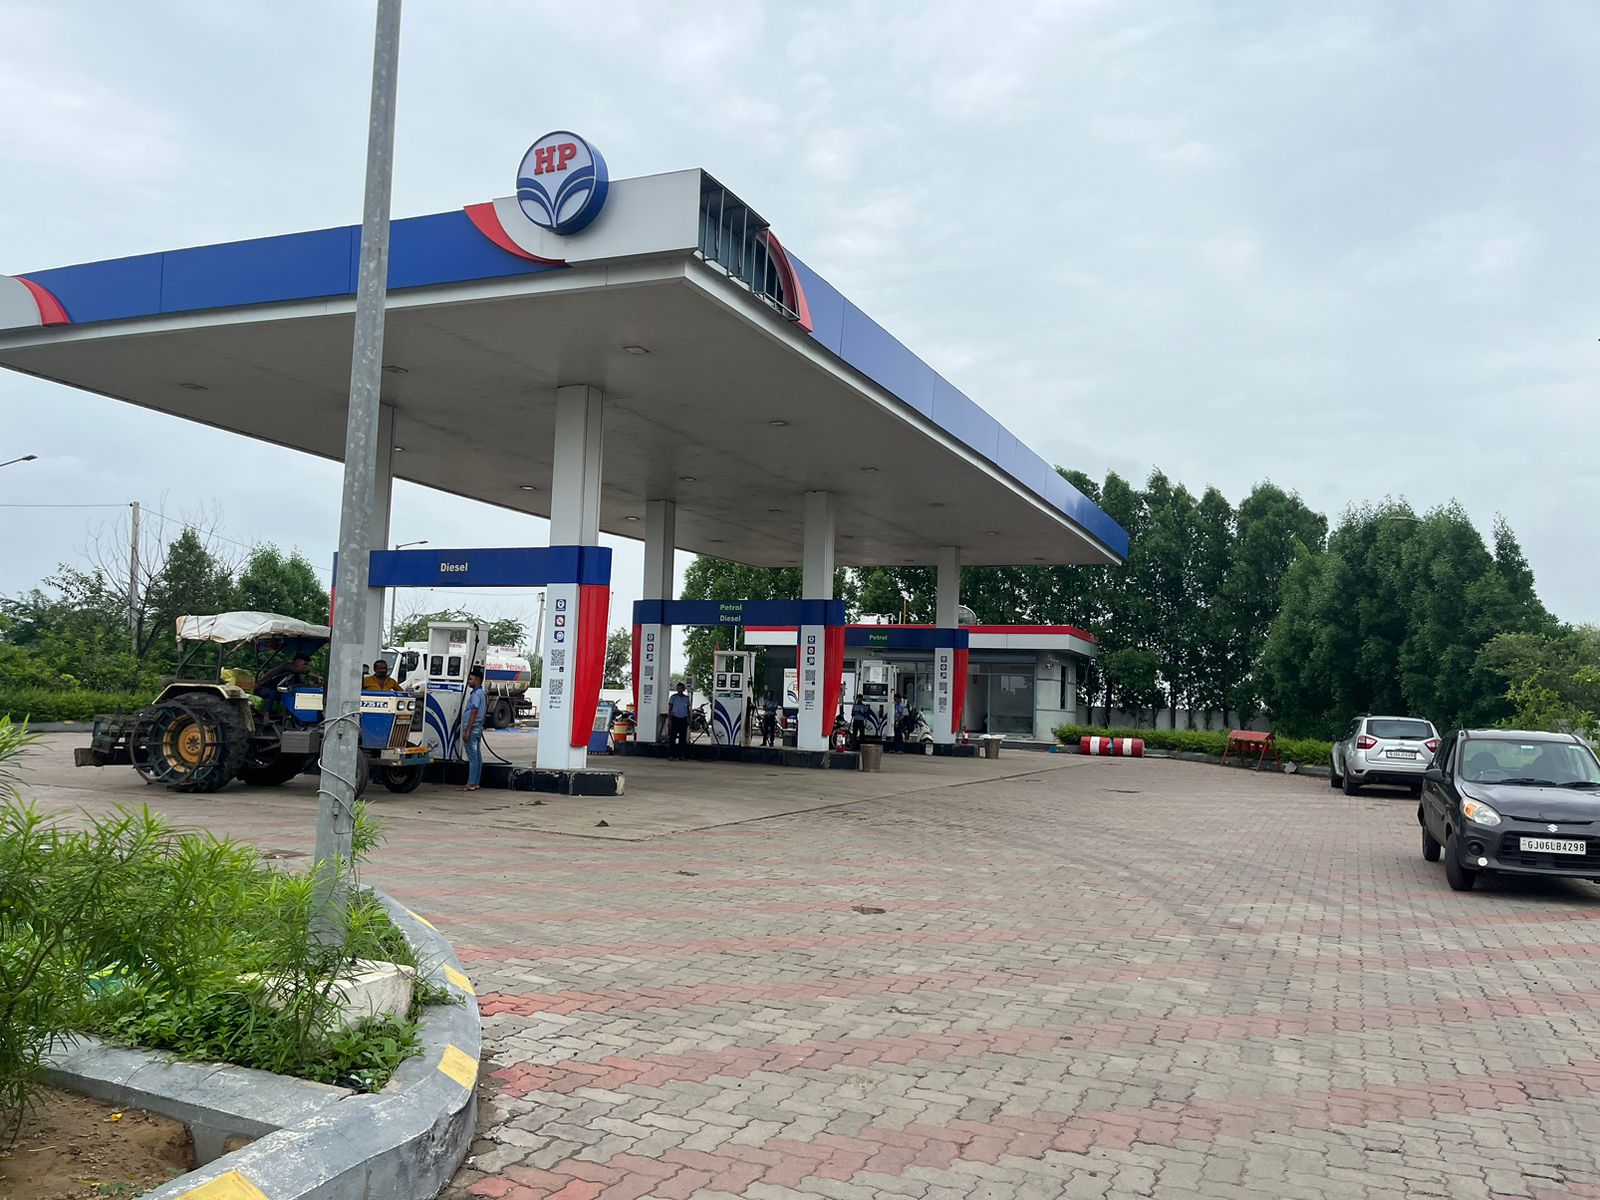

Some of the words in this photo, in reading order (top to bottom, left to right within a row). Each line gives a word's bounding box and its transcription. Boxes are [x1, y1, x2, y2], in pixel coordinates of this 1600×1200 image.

[534, 143, 577, 175] HP
[440, 562, 468, 572] Diesel
[1527, 840, 1585, 852] GJ06LB4298
